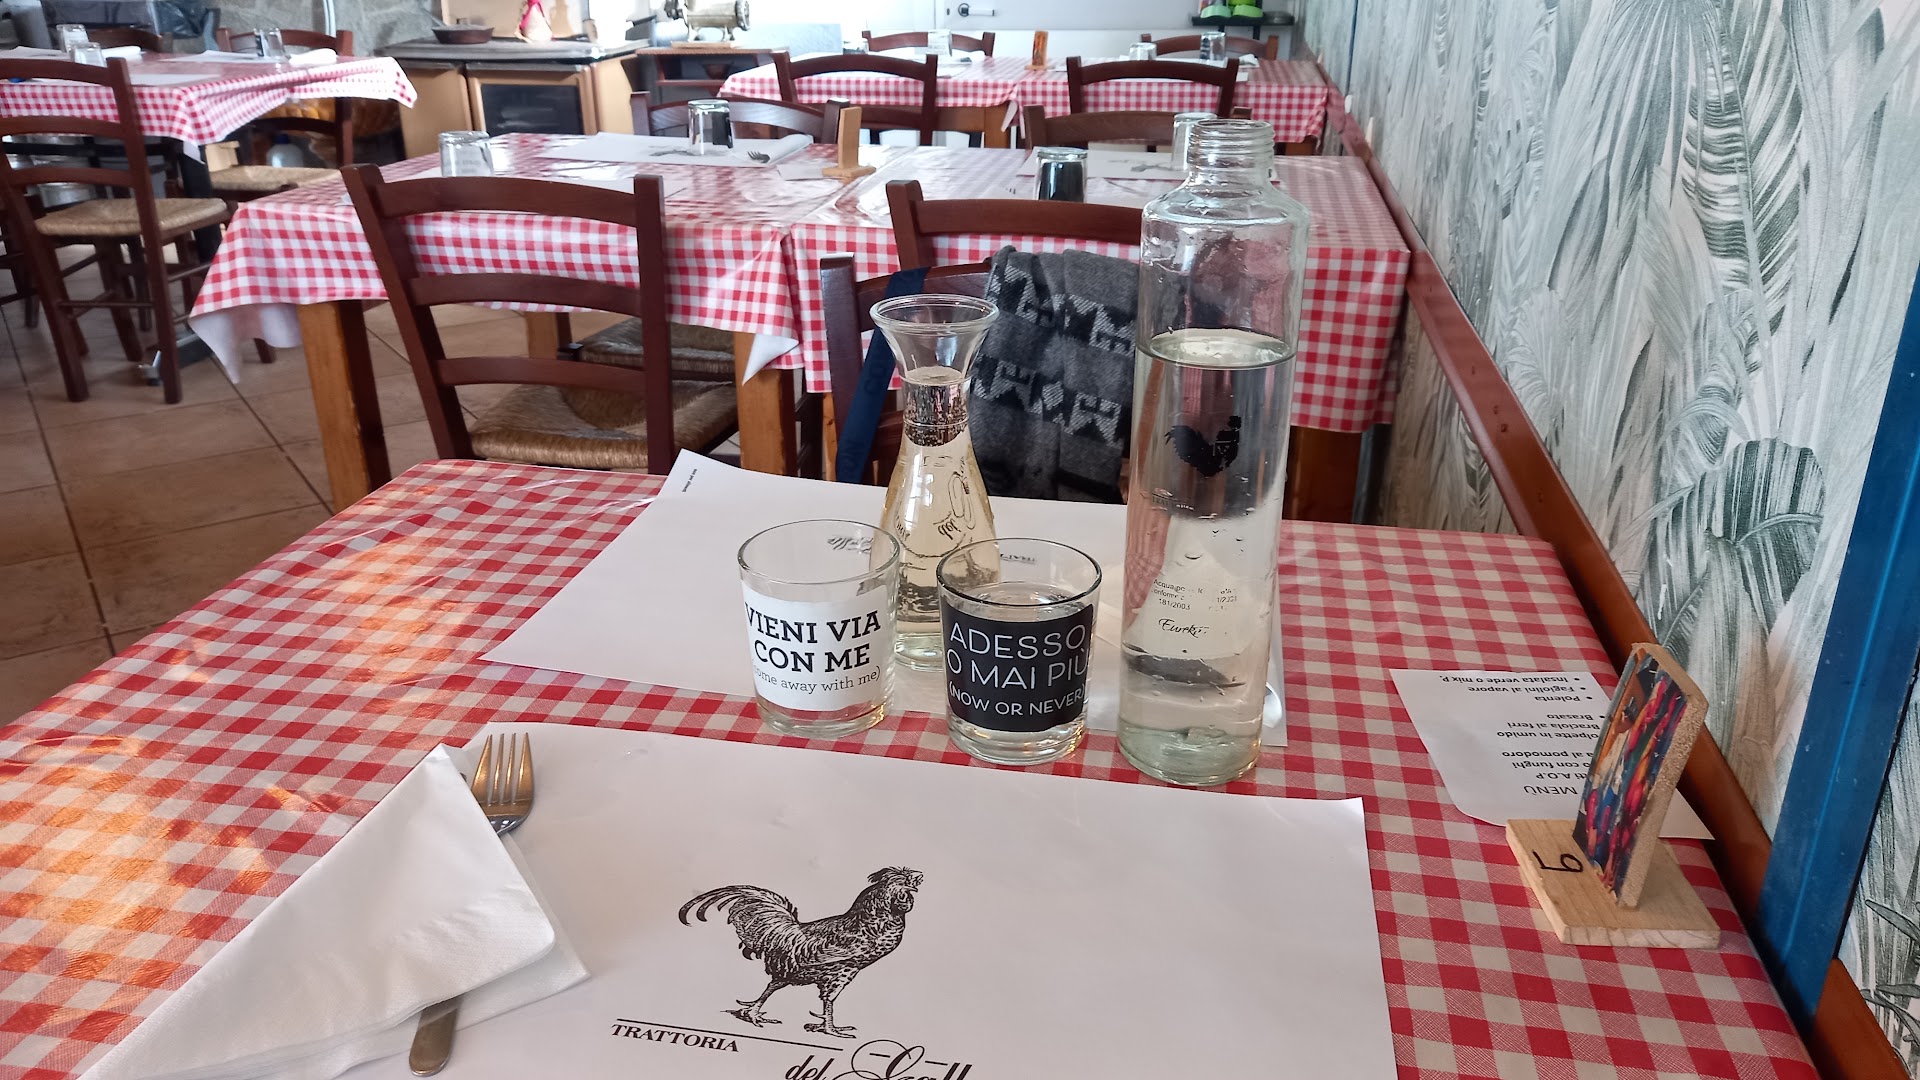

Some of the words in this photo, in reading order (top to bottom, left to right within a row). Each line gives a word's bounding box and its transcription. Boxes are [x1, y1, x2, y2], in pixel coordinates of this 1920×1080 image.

[744, 601, 818, 644] VIENI
[826, 609, 882, 642] VIA
[949, 621, 1087, 660] ADESSO
[754, 639, 815, 674] CON
[824, 643, 871, 673] ME
[946, 648, 962, 675] O
[970, 658, 1036, 690] MAI
[1047, 646, 1090, 687] PIÙ
[780, 679, 818, 696] away
[820, 675, 855, 692] with
[857, 665, 882, 687] me)
[1451, 676, 1474, 684] mix
[1486, 676, 1520, 684] verde
[1467, 685, 1510, 694] vapore
[1510, 685, 1523, 694] al
[1524, 685, 1575, 694] Fagiolini
[949, 680, 990, 712] (NOW
[994, 701, 1024, 716] OR
[1028, 682, 1086, 715] NEVER)
[1506, 721, 1534, 730] ferri
[1549, 723, 1601, 731] Braciola
[1496, 731, 1537, 740] umido
[1539, 731, 1553, 739] in
[1554, 731, 1600, 740] olpette
[1501, 750, 1570, 758] pomodoro
[1571, 751, 1584, 759] al
[1511, 760, 1555, 769] funghi
[1523, 785, 1579, 796] MENÙ
[610, 1023, 740, 1053] TRATTORIA
